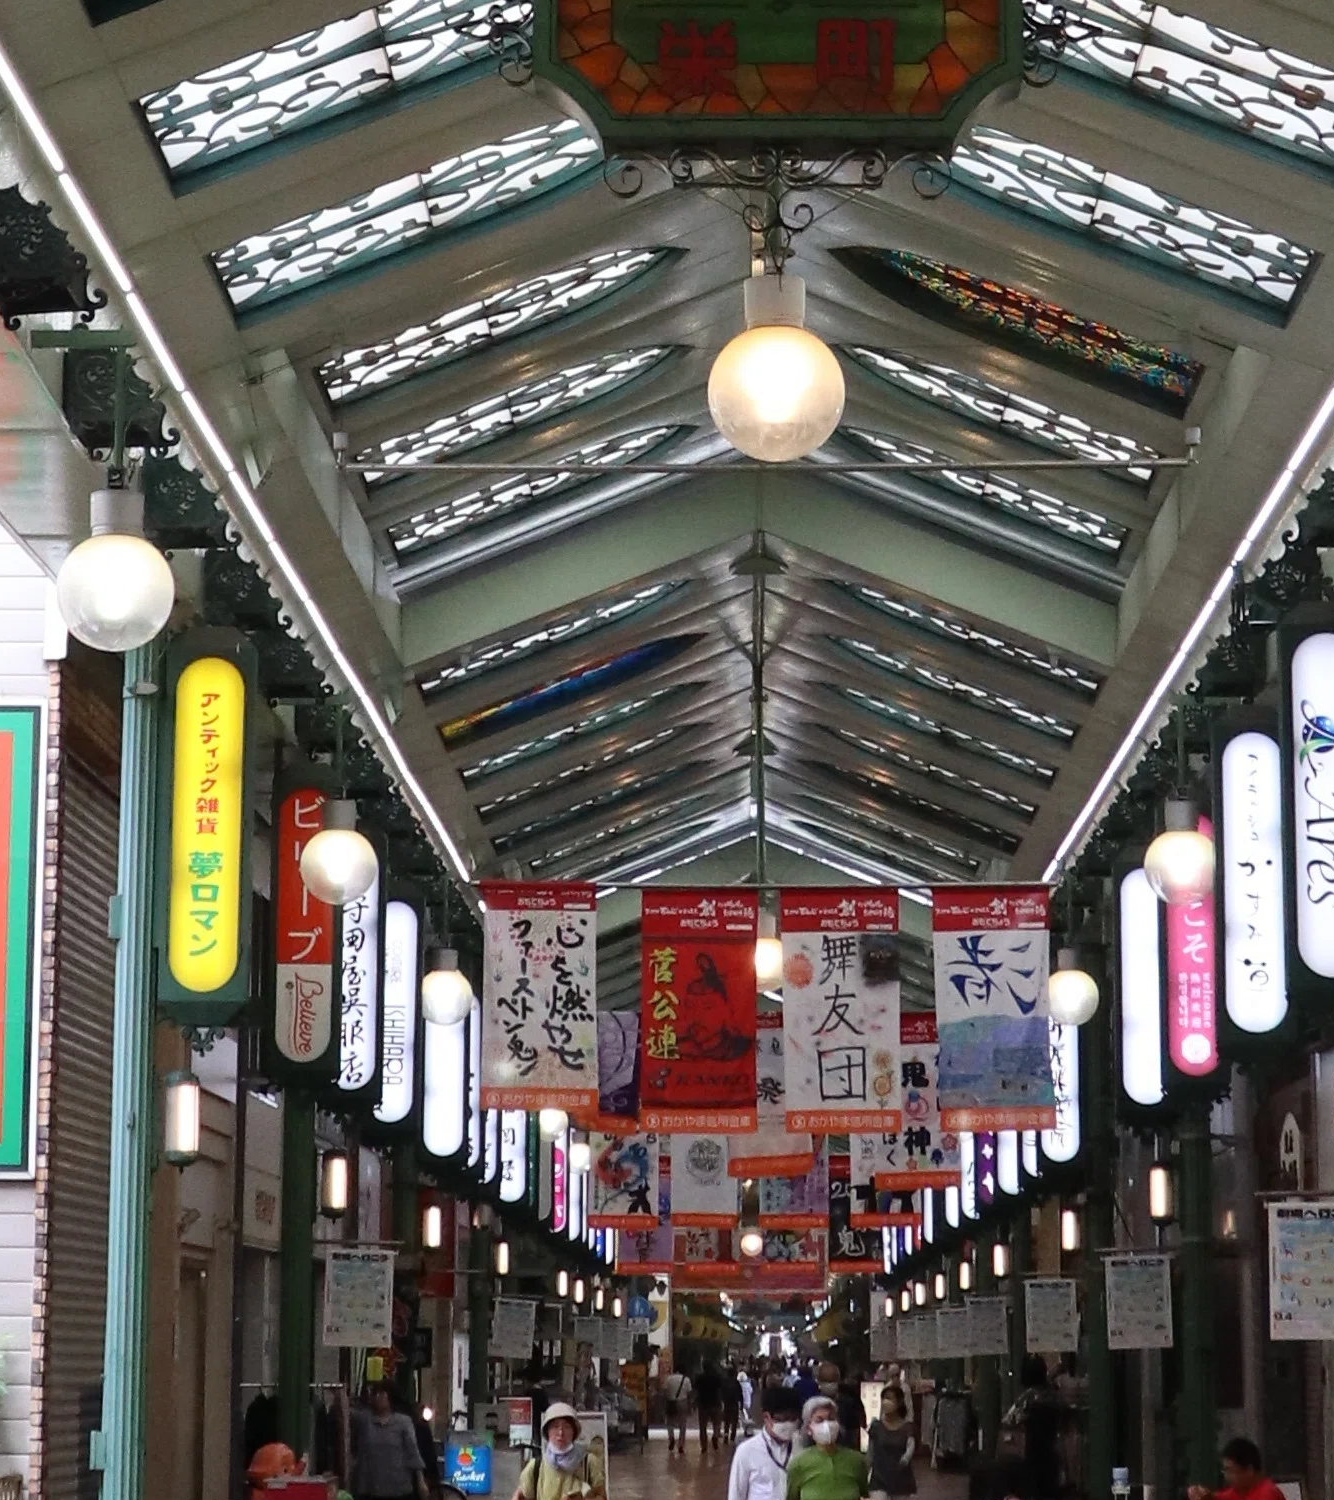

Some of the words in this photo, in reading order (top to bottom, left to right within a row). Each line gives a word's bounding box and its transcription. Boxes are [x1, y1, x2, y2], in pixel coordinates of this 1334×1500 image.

[657, 20, 895, 99] 栄町
[195, 693, 220, 835] アンティック雑貨
[188, 851, 223, 957] 夢ロマン
[289, 797, 324, 960] ビーブ
[293, 972, 324, 1055] Believe
[812, 935, 867, 1101] 舞友団
